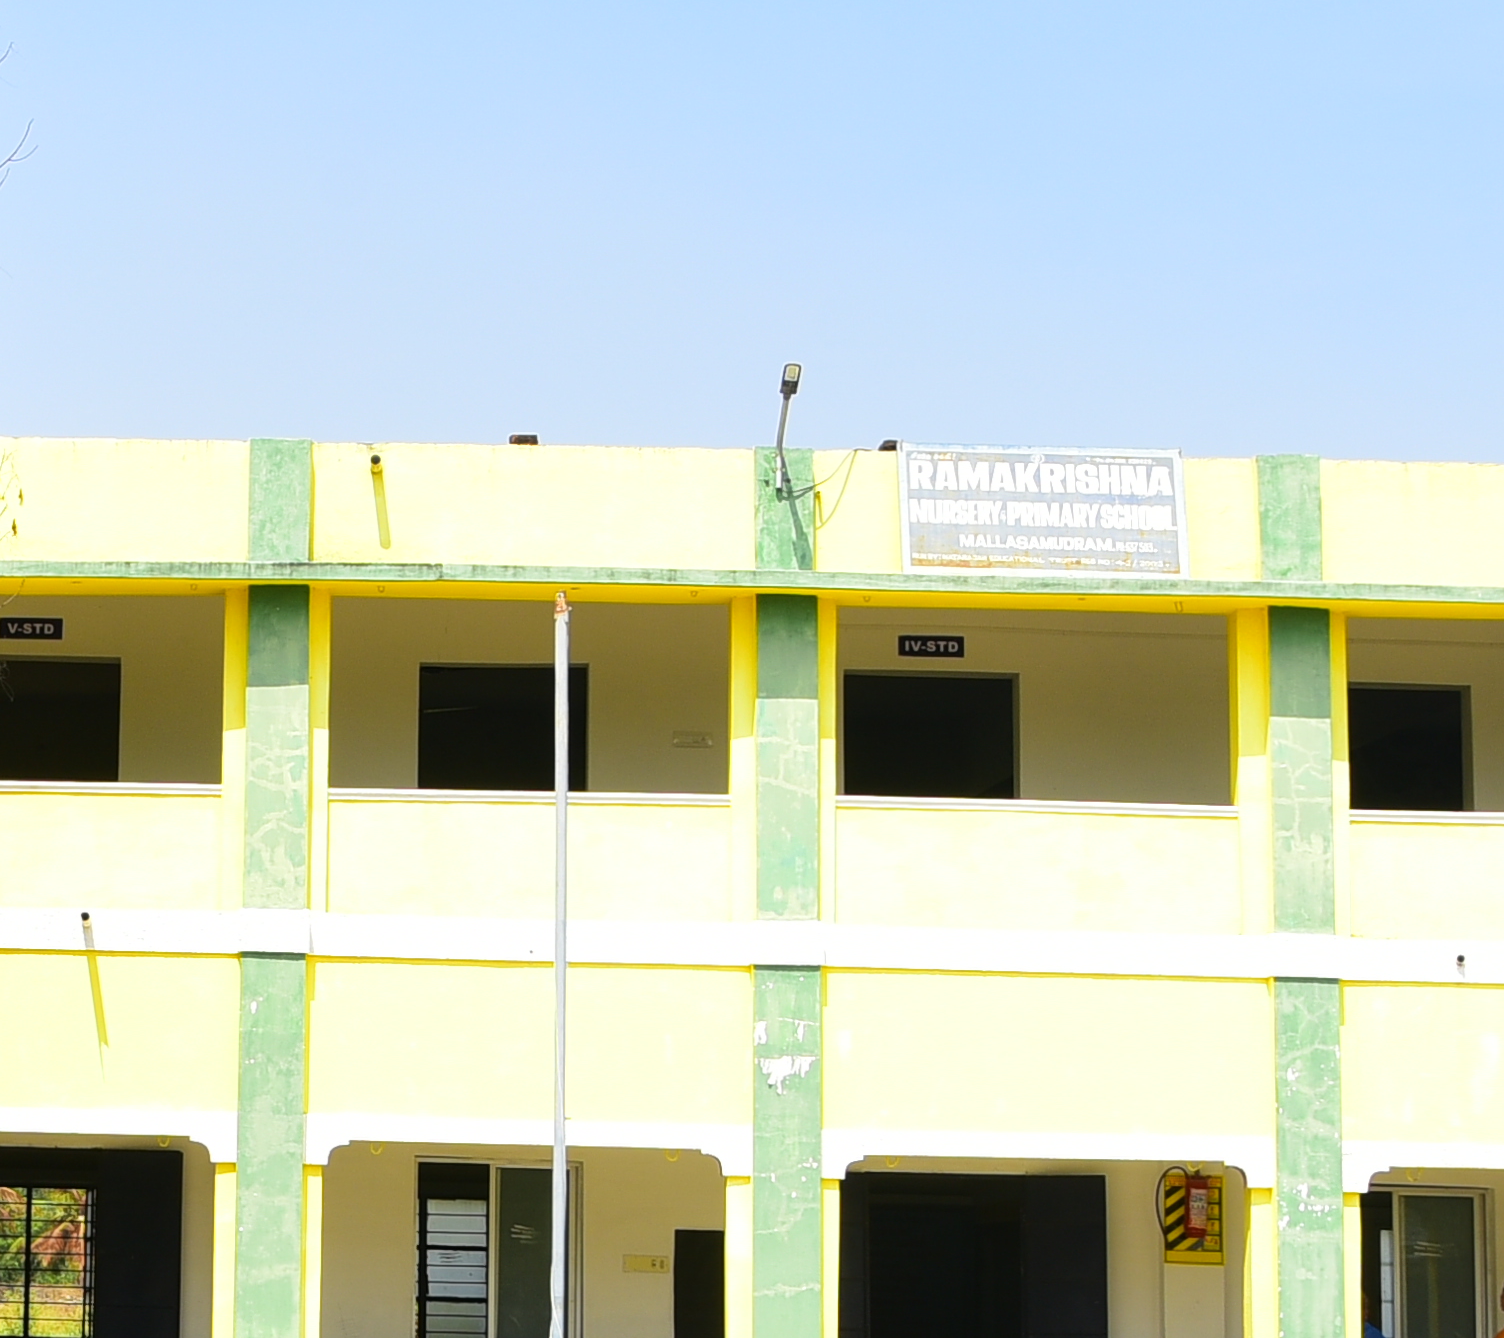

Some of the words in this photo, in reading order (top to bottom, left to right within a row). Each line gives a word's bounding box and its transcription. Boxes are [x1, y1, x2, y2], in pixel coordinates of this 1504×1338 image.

[908, 459, 1174, 497] RAMAKRISHNA
[908, 499, 1003, 526] NURSERY
[1006, 501, 1100, 528] PRIMARY
[1100, 503, 1177, 531] SCHOOL
[989, 555, 1046, 564] EDUCATIONAL
[7, 622, 55, 635] V-STD
[904, 640, 959, 653] IV-STD
